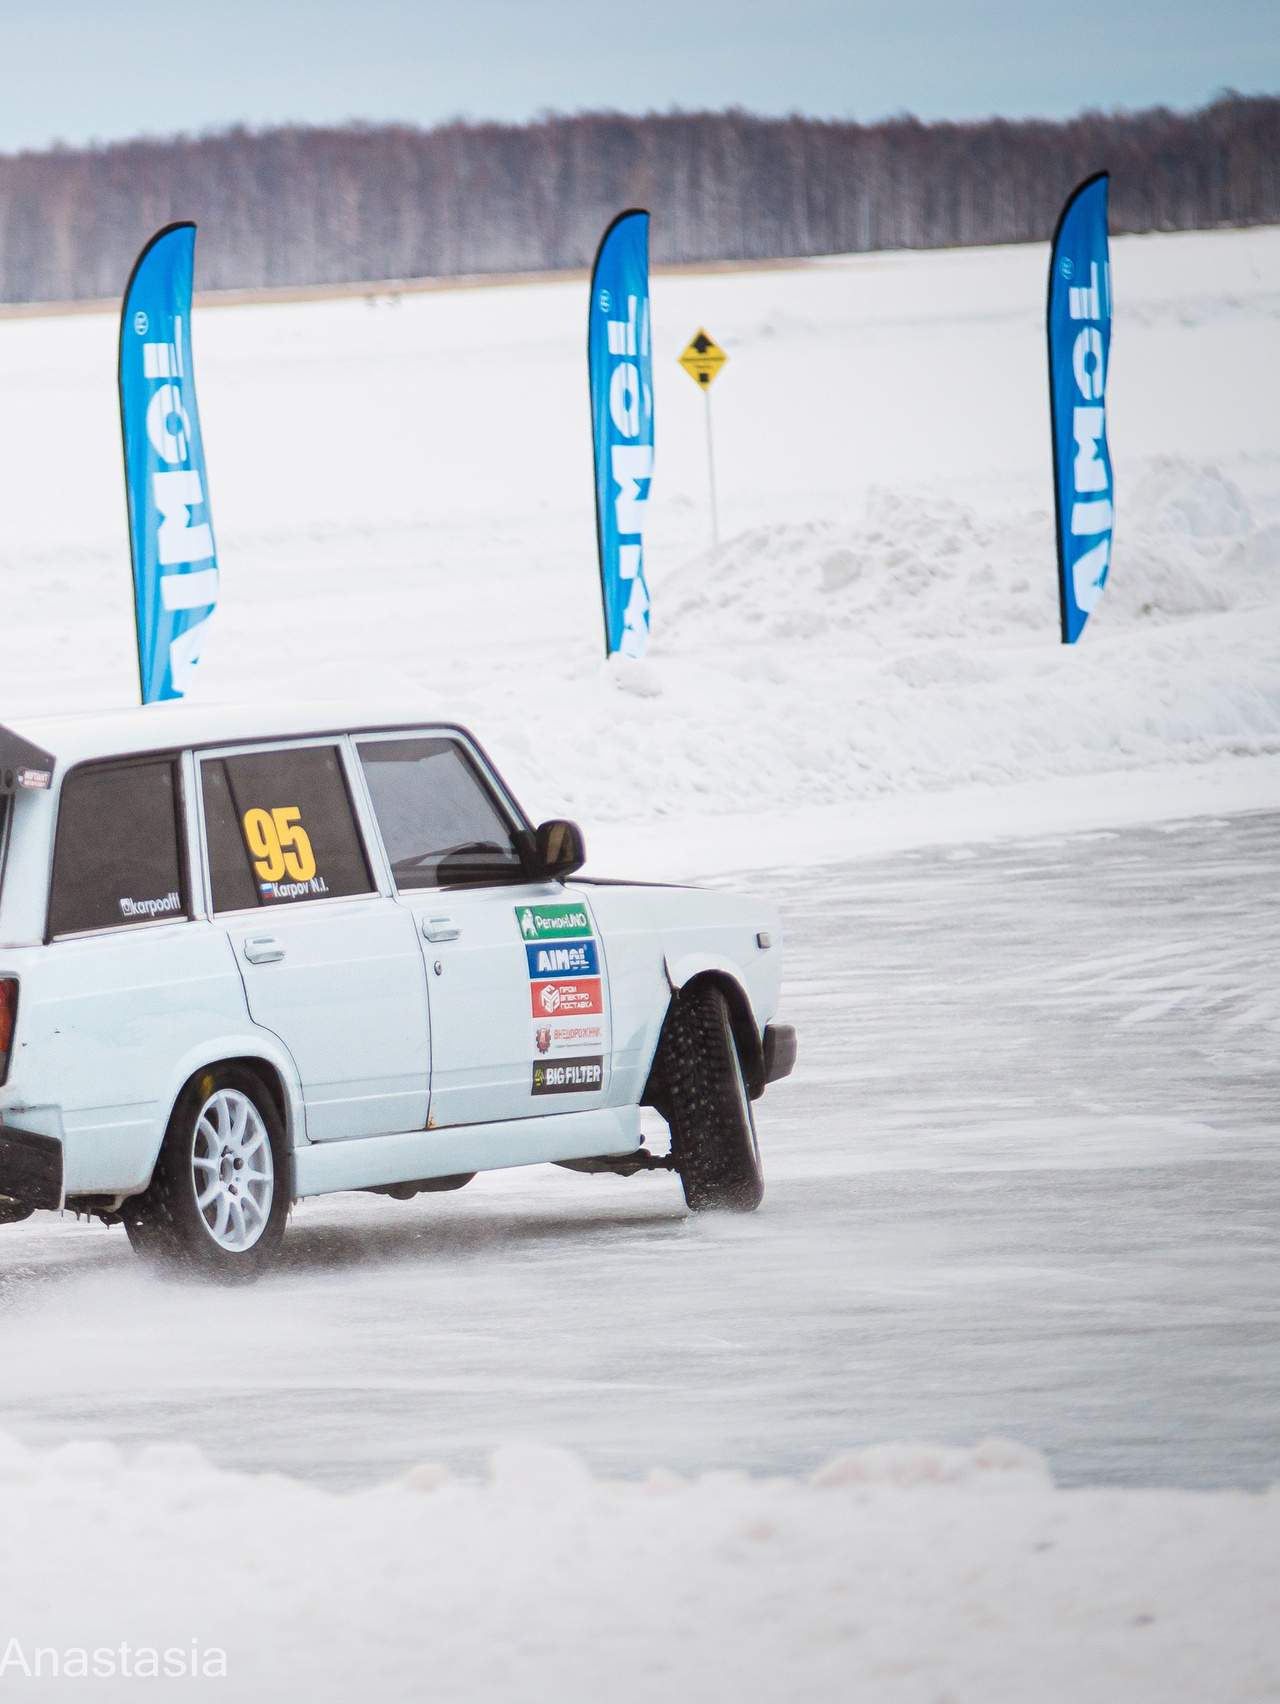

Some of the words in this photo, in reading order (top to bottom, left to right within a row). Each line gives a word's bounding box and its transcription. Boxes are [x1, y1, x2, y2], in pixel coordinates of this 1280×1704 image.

[243, 806, 316, 881] 95
[272, 882, 309, 898] Karpov
[538, 947, 590, 971] AIMOL
[546, 1067, 565, 1085] BIG
[566, 1065, 600, 1084] FILTER
